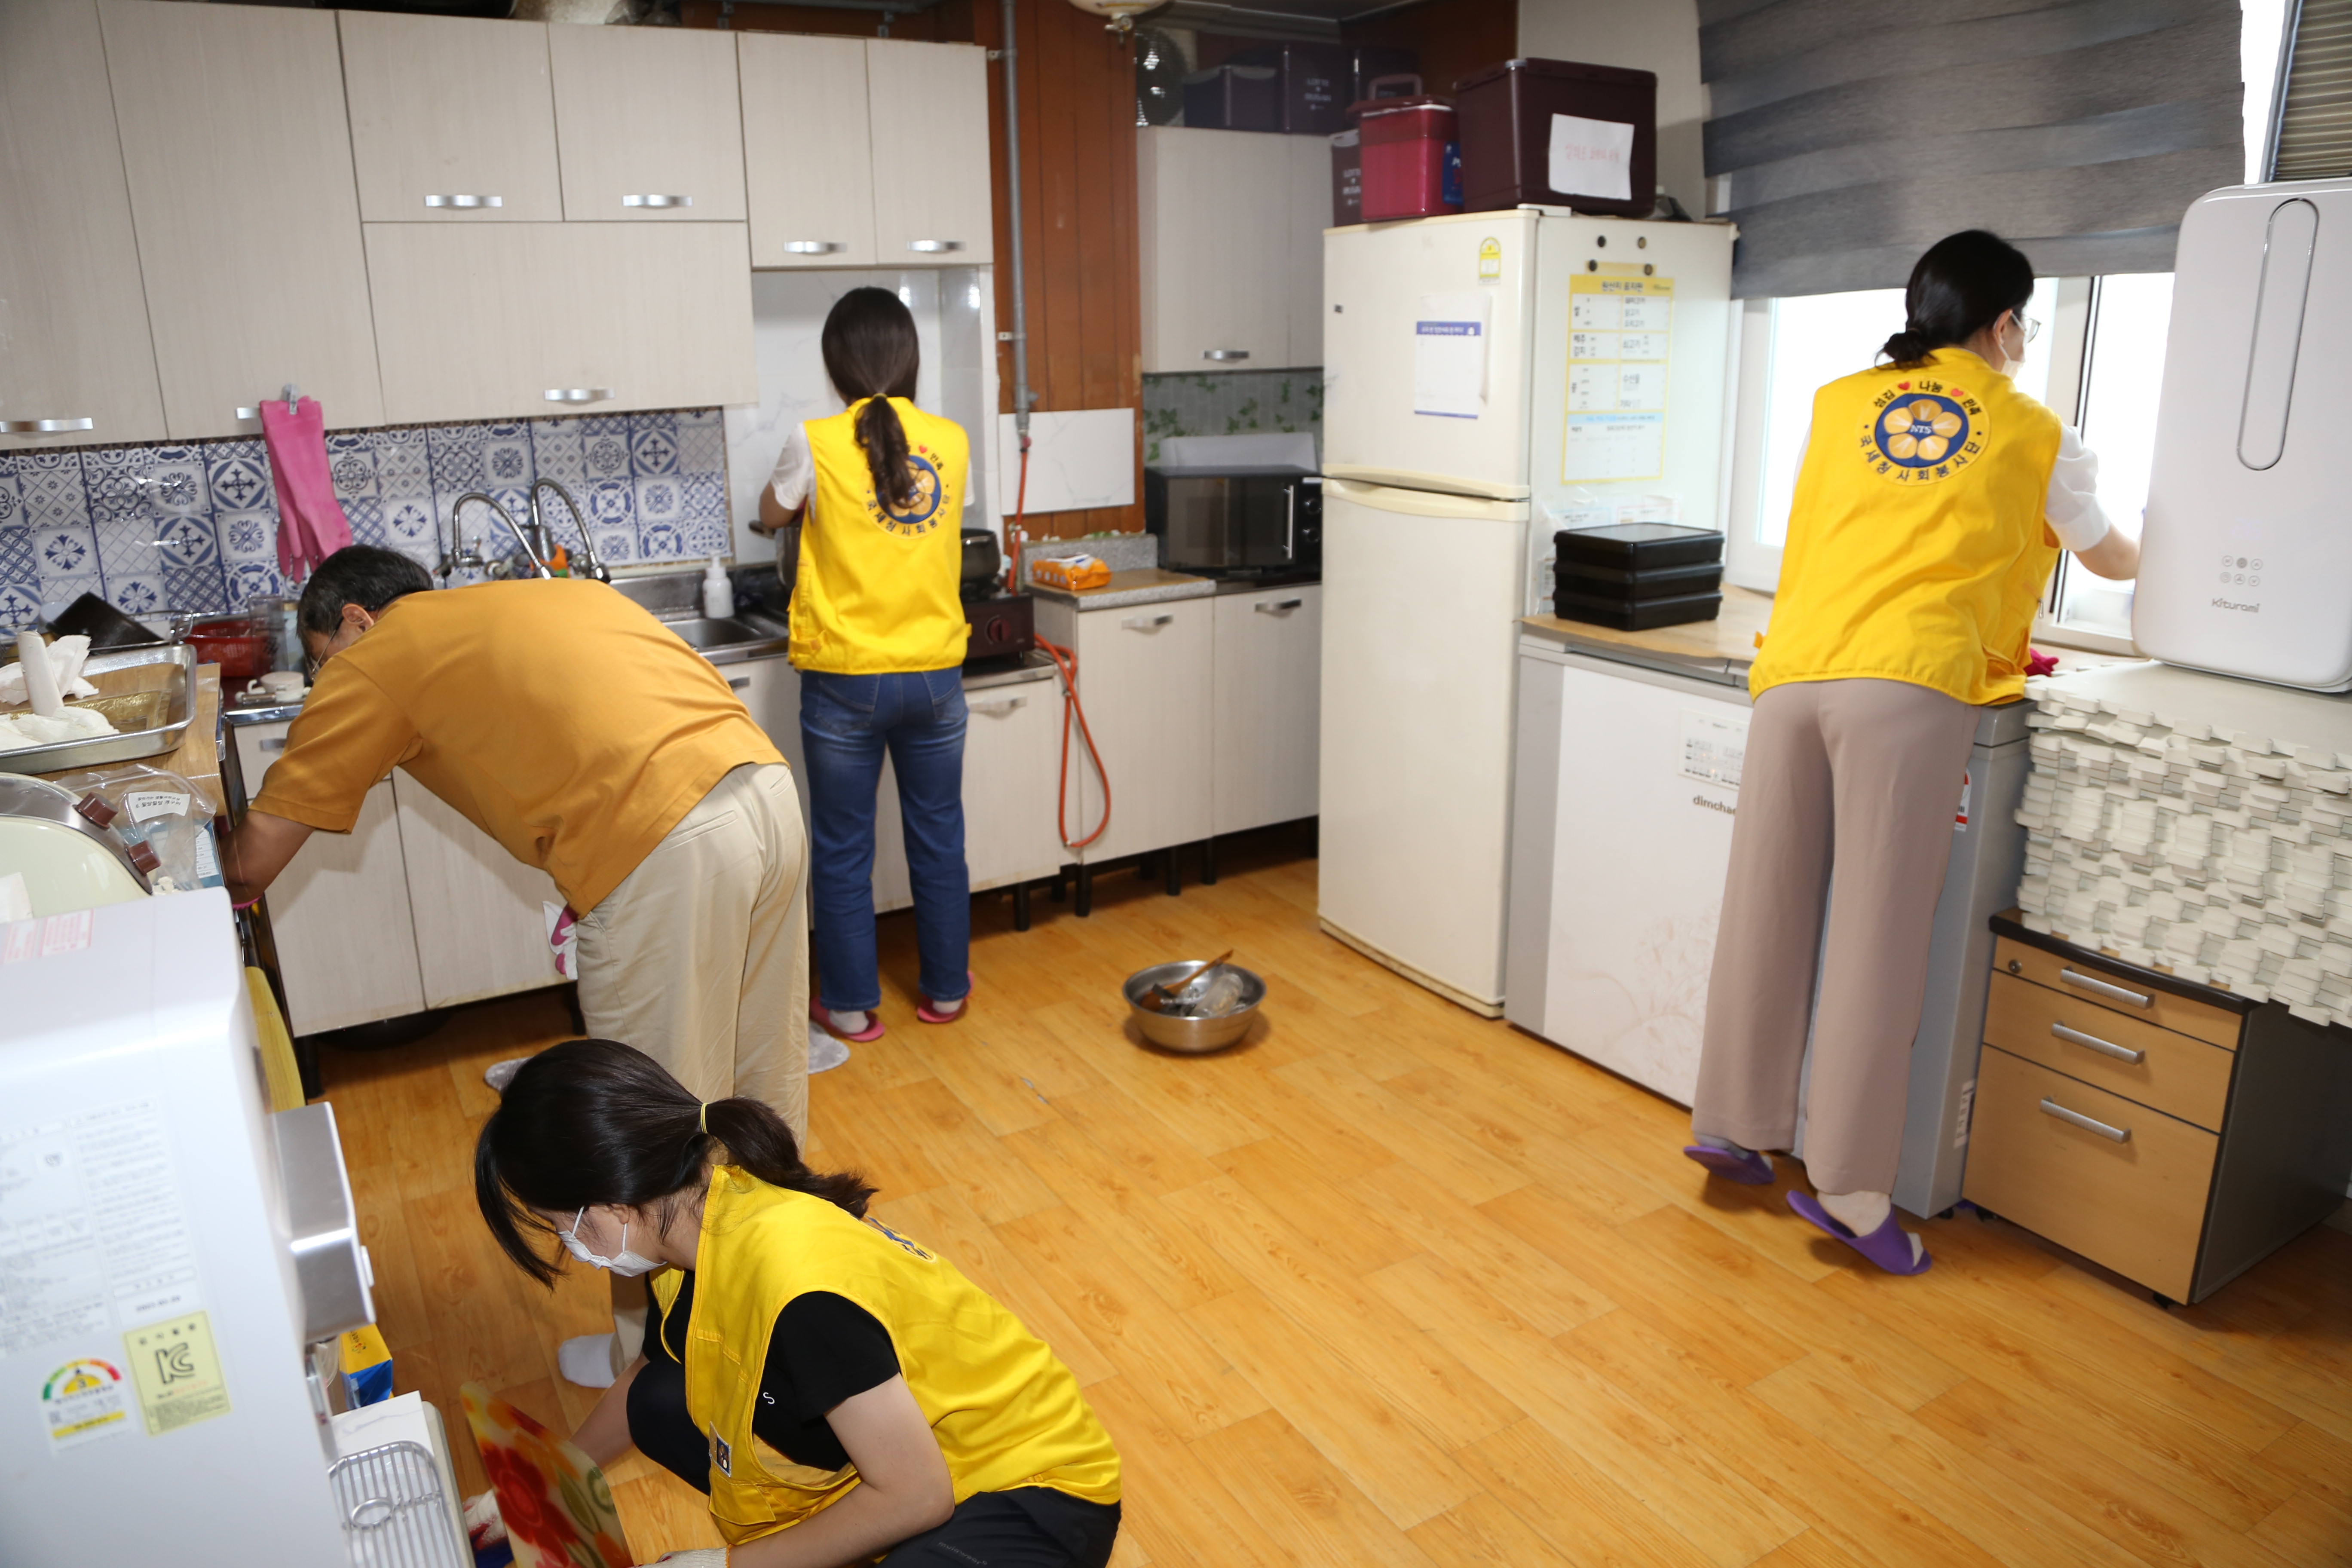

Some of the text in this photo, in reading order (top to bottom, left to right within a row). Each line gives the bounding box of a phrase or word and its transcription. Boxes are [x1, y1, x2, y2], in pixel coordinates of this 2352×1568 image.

[1873, 380, 1984, 416] 섬김 나눔 만족
[1910, 424, 1933, 435] NTS
[2211, 598, 2260, 613] Kiturami
[763, 1392, 775, 1404] S
